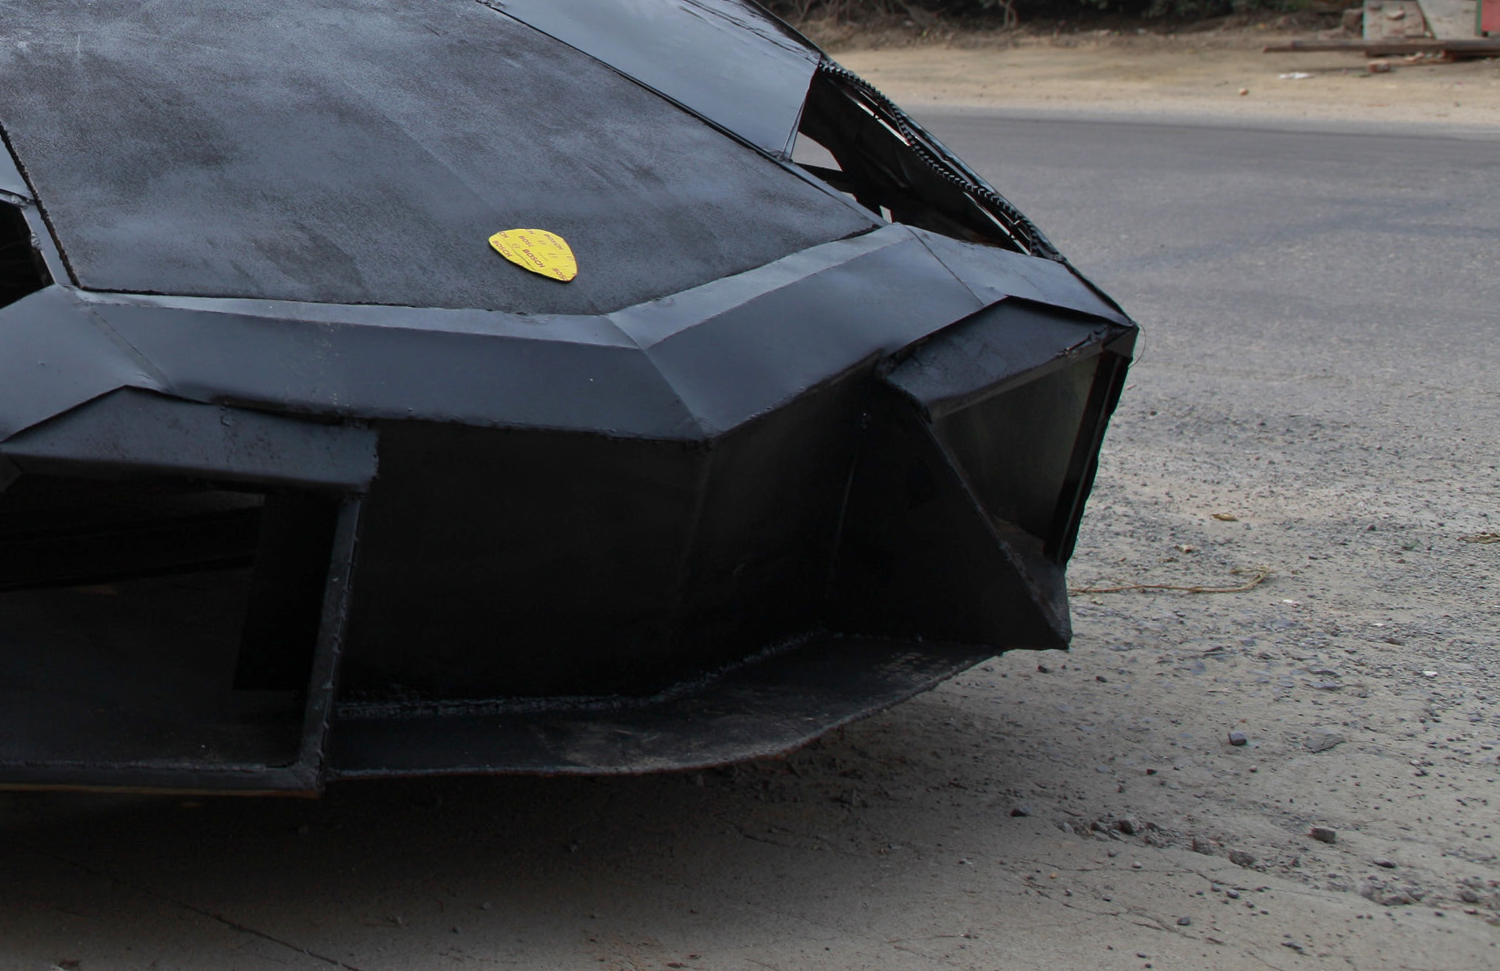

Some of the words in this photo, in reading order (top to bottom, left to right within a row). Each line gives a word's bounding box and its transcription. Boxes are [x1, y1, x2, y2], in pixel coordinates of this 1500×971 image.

[492, 240, 513, 258] BOSCH
[543, 233, 565, 250] BOSCH
[522, 248, 545, 268] BOSCH
